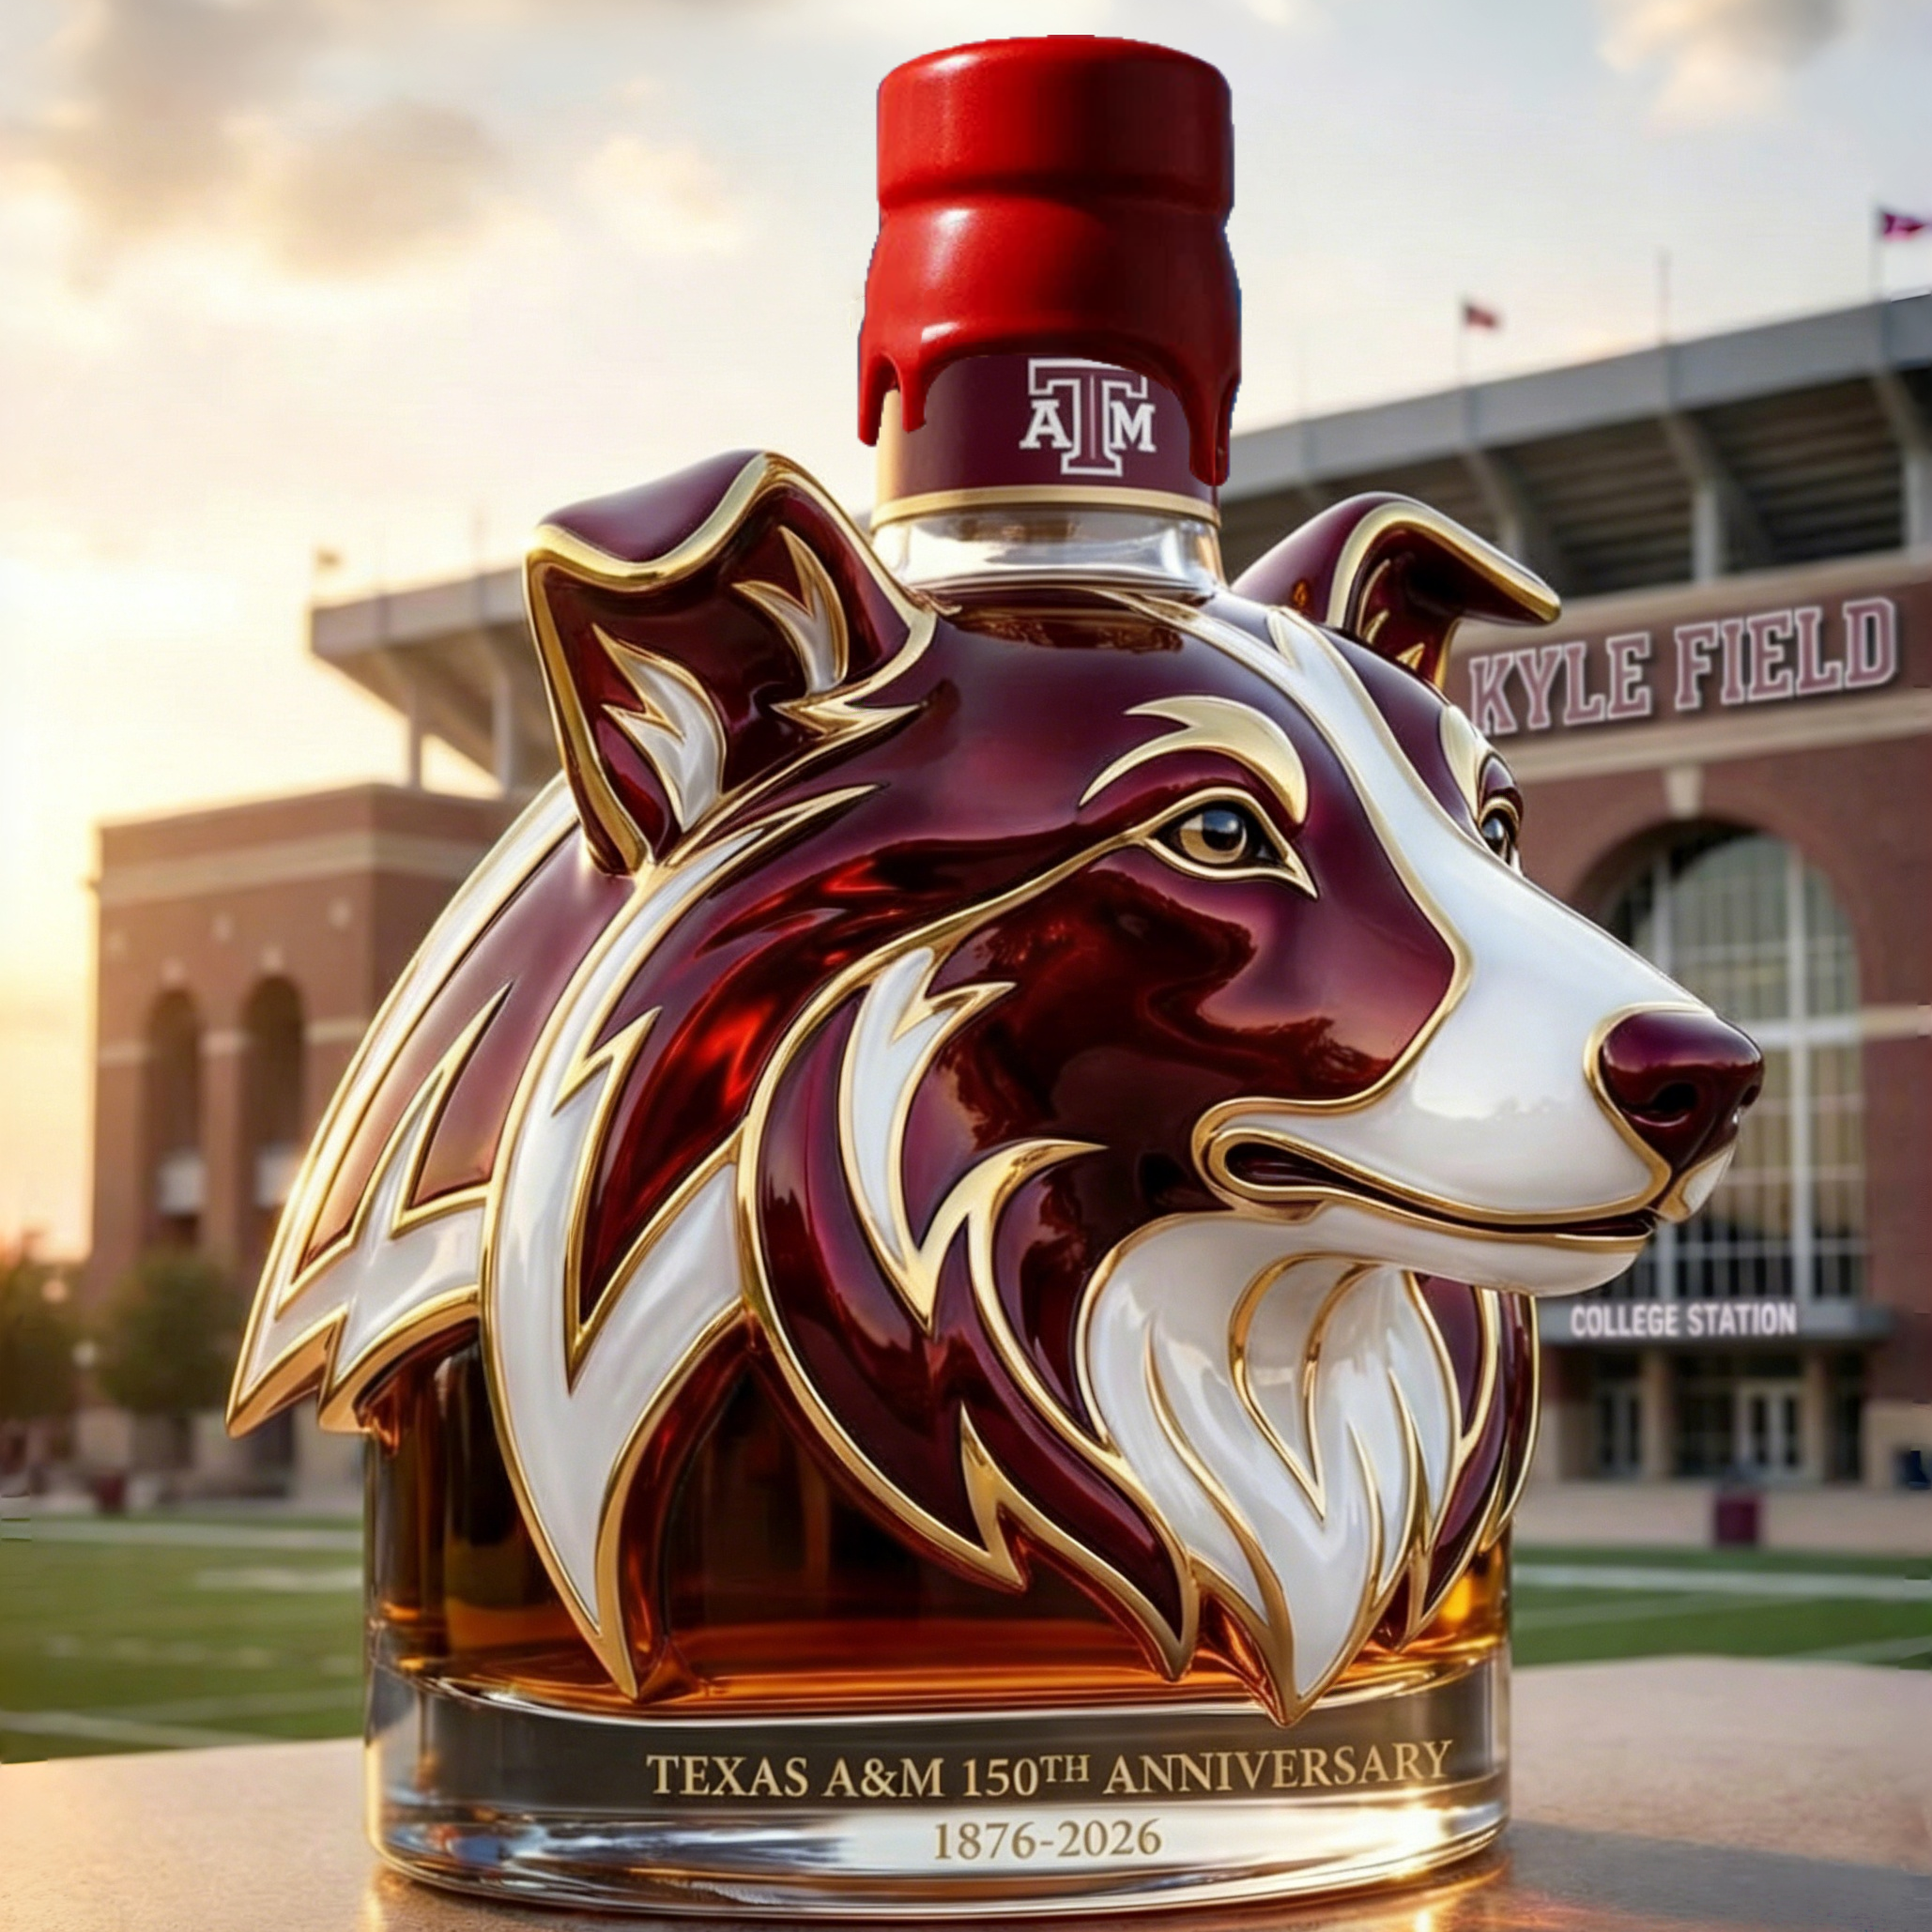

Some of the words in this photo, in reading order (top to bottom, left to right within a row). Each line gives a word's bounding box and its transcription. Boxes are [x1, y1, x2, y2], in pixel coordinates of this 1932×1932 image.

[1468, 631, 1652, 736] KYLE
[1674, 596, 1898, 711] FIELD
[1571, 1303, 1679, 1338] COLLEGE
[1687, 1301, 1798, 1337] STATION
[646, 1754, 809, 1798] TEXAS
[820, 1756, 945, 1798] A&M
[961, 1754, 1091, 1798] 150TH
[1102, 1740, 1453, 1795] ANNIVERSARY
[934, 1817, 1162, 1861] 1876-2026
